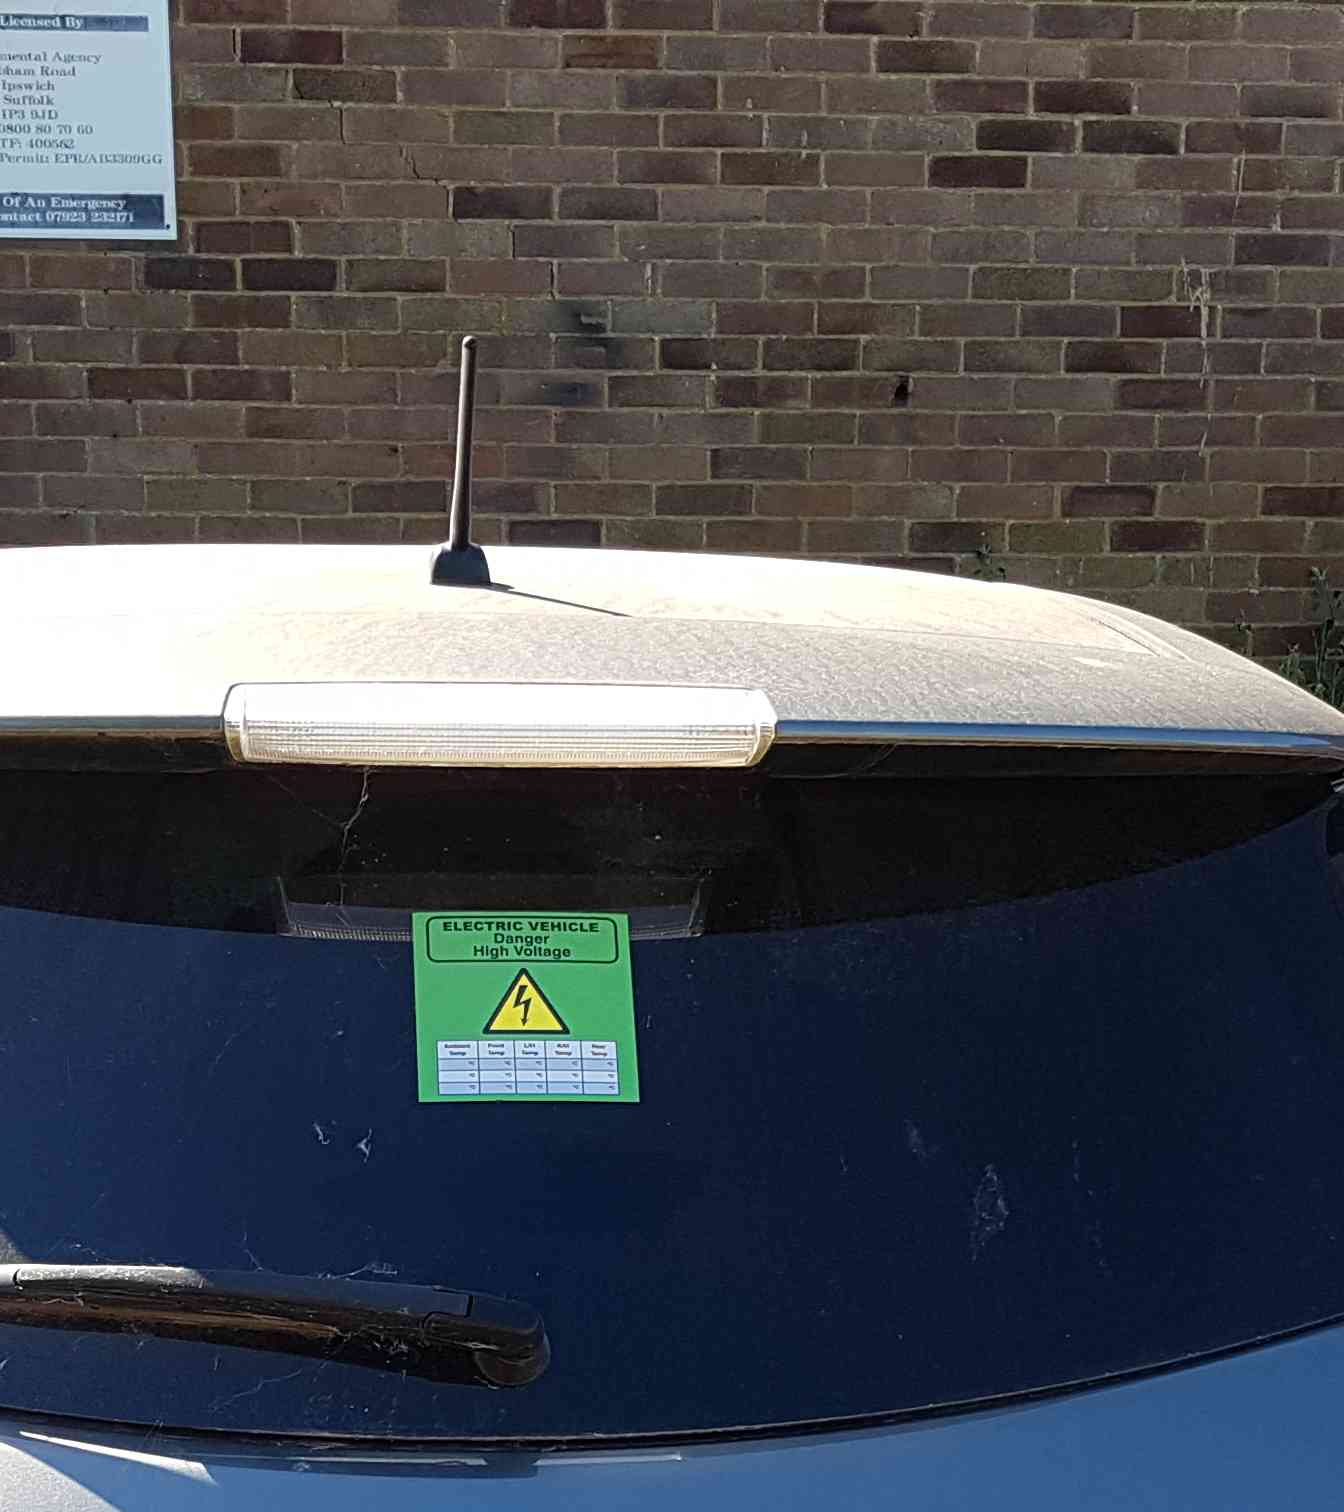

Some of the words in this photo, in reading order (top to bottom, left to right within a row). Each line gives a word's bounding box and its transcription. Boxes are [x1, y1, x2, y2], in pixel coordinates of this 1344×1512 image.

[0, 14, 61, 28] Licensed
[65, 16, 82, 30] By
[52, 51, 103, 65] Agency
[40, 65, 77, 77] Road
[1, 79, 56, 92] Ipswich
[2, 94, 55, 106] Suffolk
[1, 108, 26, 120] IP3
[57, 124, 73, 135] 70
[2, 196, 21, 208] Of
[24, 196, 46, 208] An
[50, 196, 127, 210] Emergency
[442, 921, 524, 932] ELECTRIC
[527, 921, 600, 933] VEHICLE
[493, 933, 550, 947] Danger
[473, 946, 509, 960] High
[514, 946, 572, 960] Voltage
